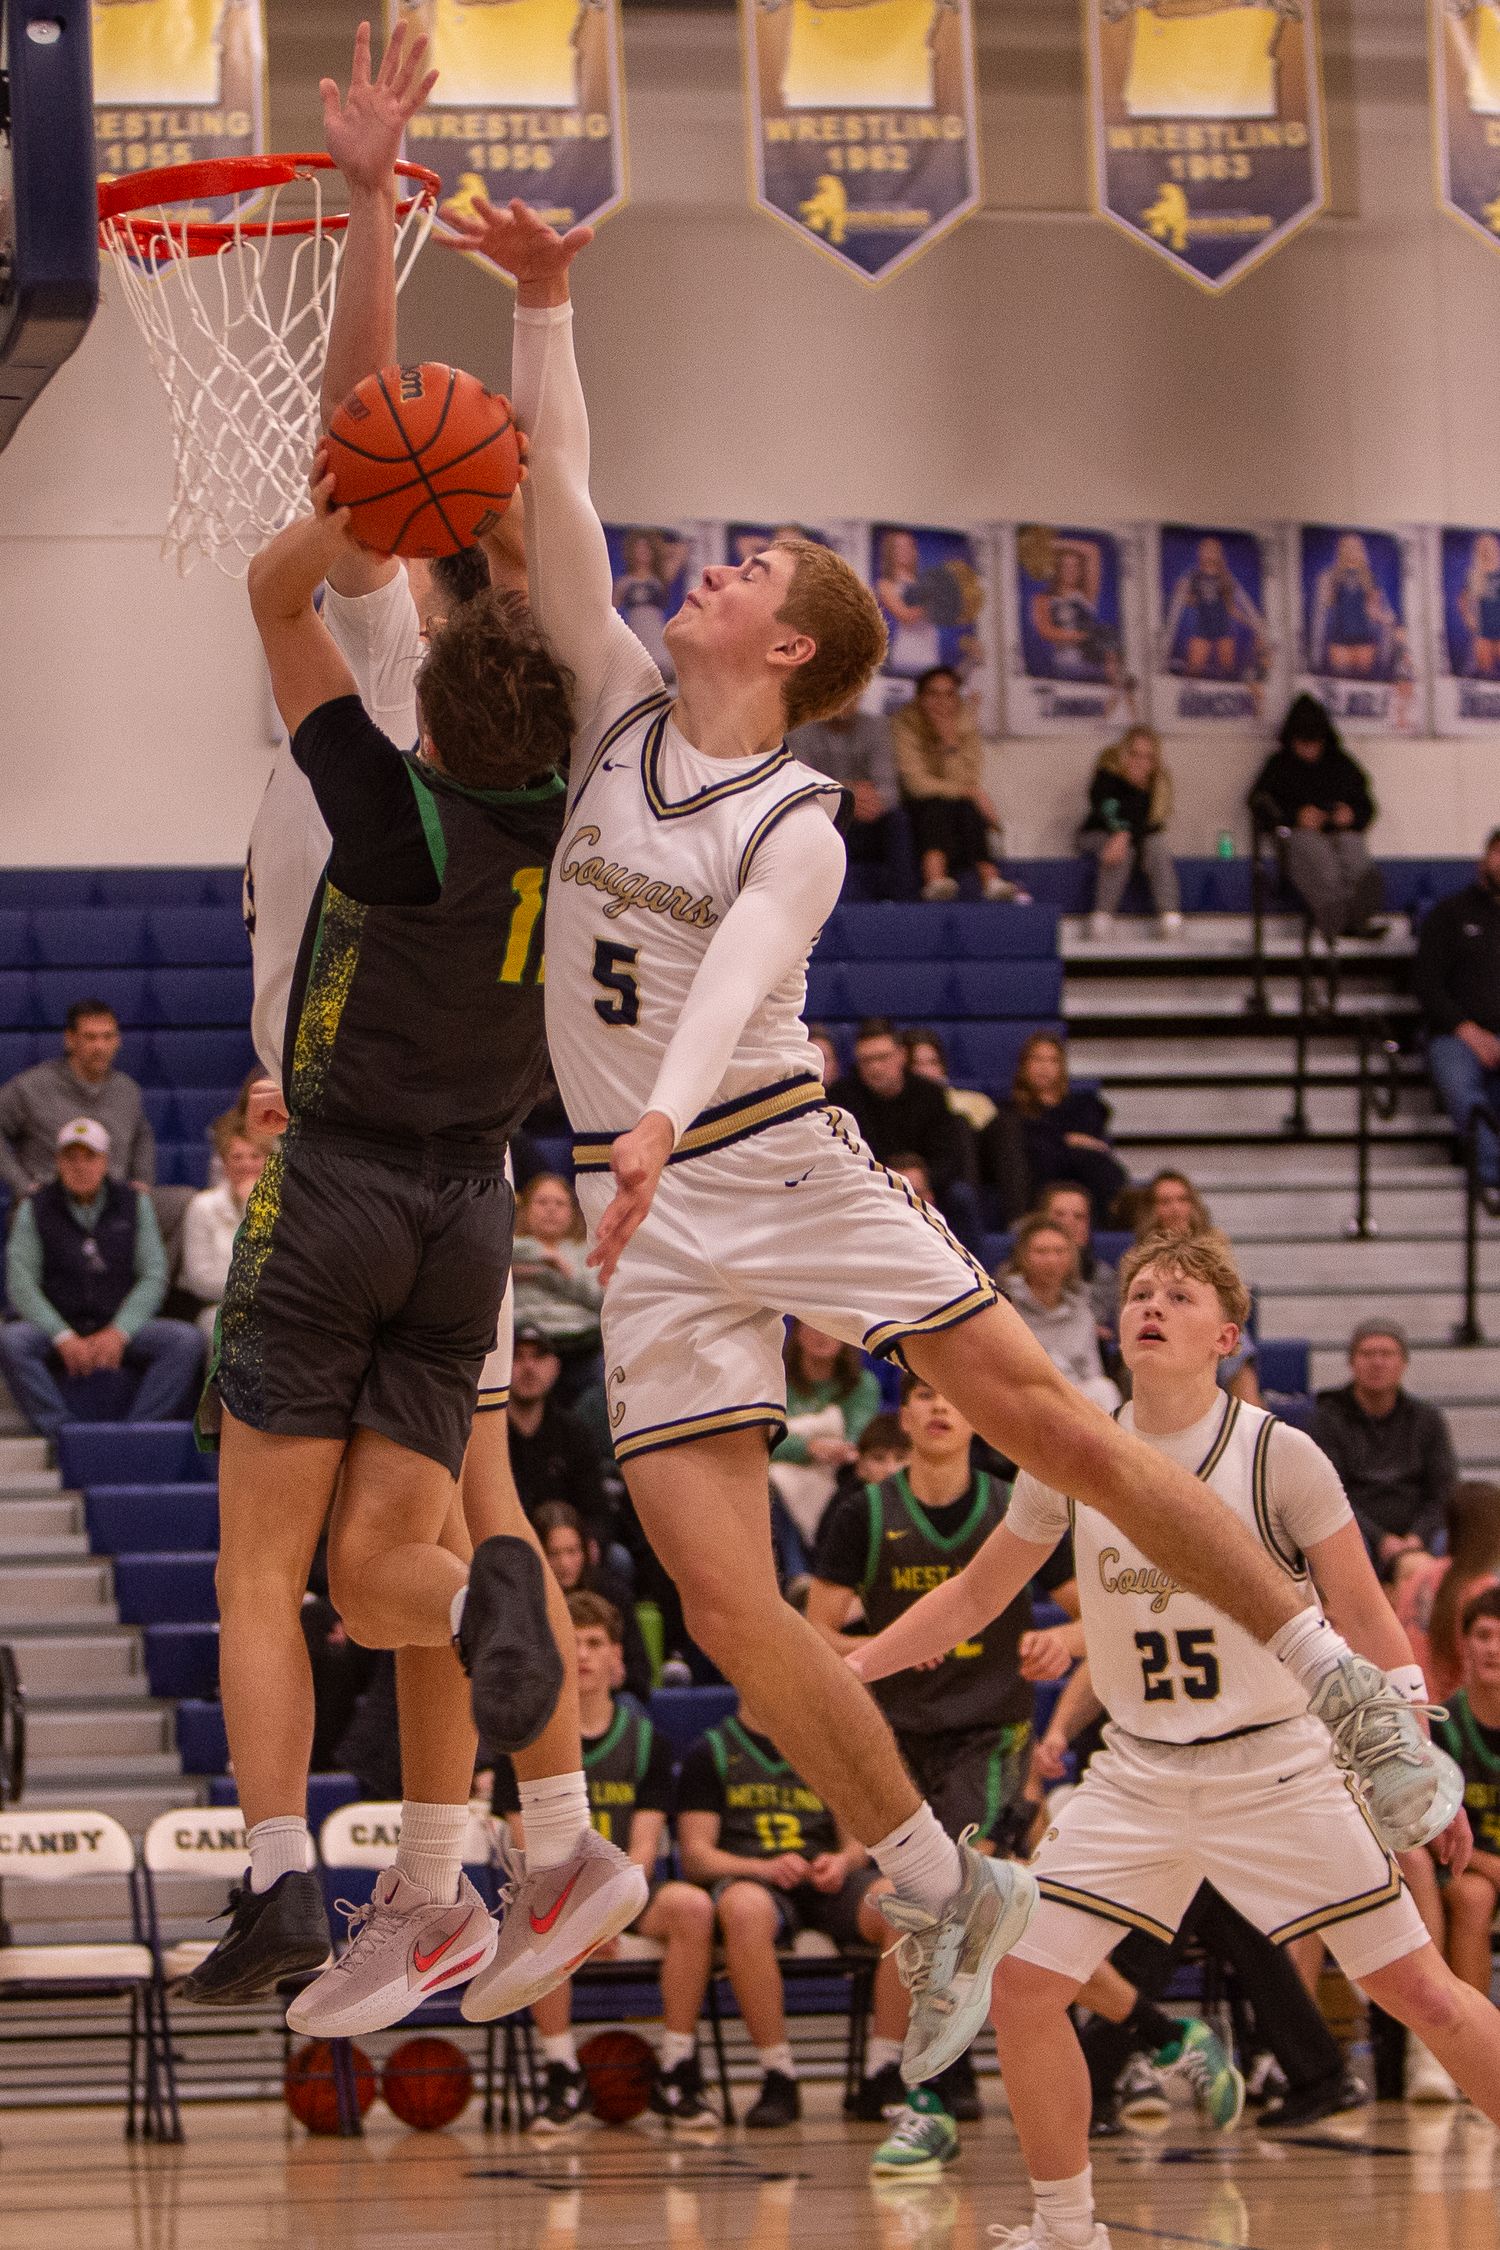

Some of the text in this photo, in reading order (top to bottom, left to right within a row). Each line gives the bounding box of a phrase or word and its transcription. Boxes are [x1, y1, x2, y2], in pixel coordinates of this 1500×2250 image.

[94, 111, 250, 140] ESTLING
[409, 112, 609, 139] WRESTLING
[766, 115, 965, 141] WRESTLING
[1108, 121, 1308, 149] WRESTLING
[560, 825, 719, 929] Cougars
[499, 865, 545, 984] 1
[592, 935, 642, 1027] 5
[1099, 1547, 1190, 1614] Coug
[1134, 1629, 1221, 1703] 25
[0, 1829, 103, 1854] CANBY
[174, 1828, 249, 1851] CAN
[755, 1812, 806, 1850] 12
